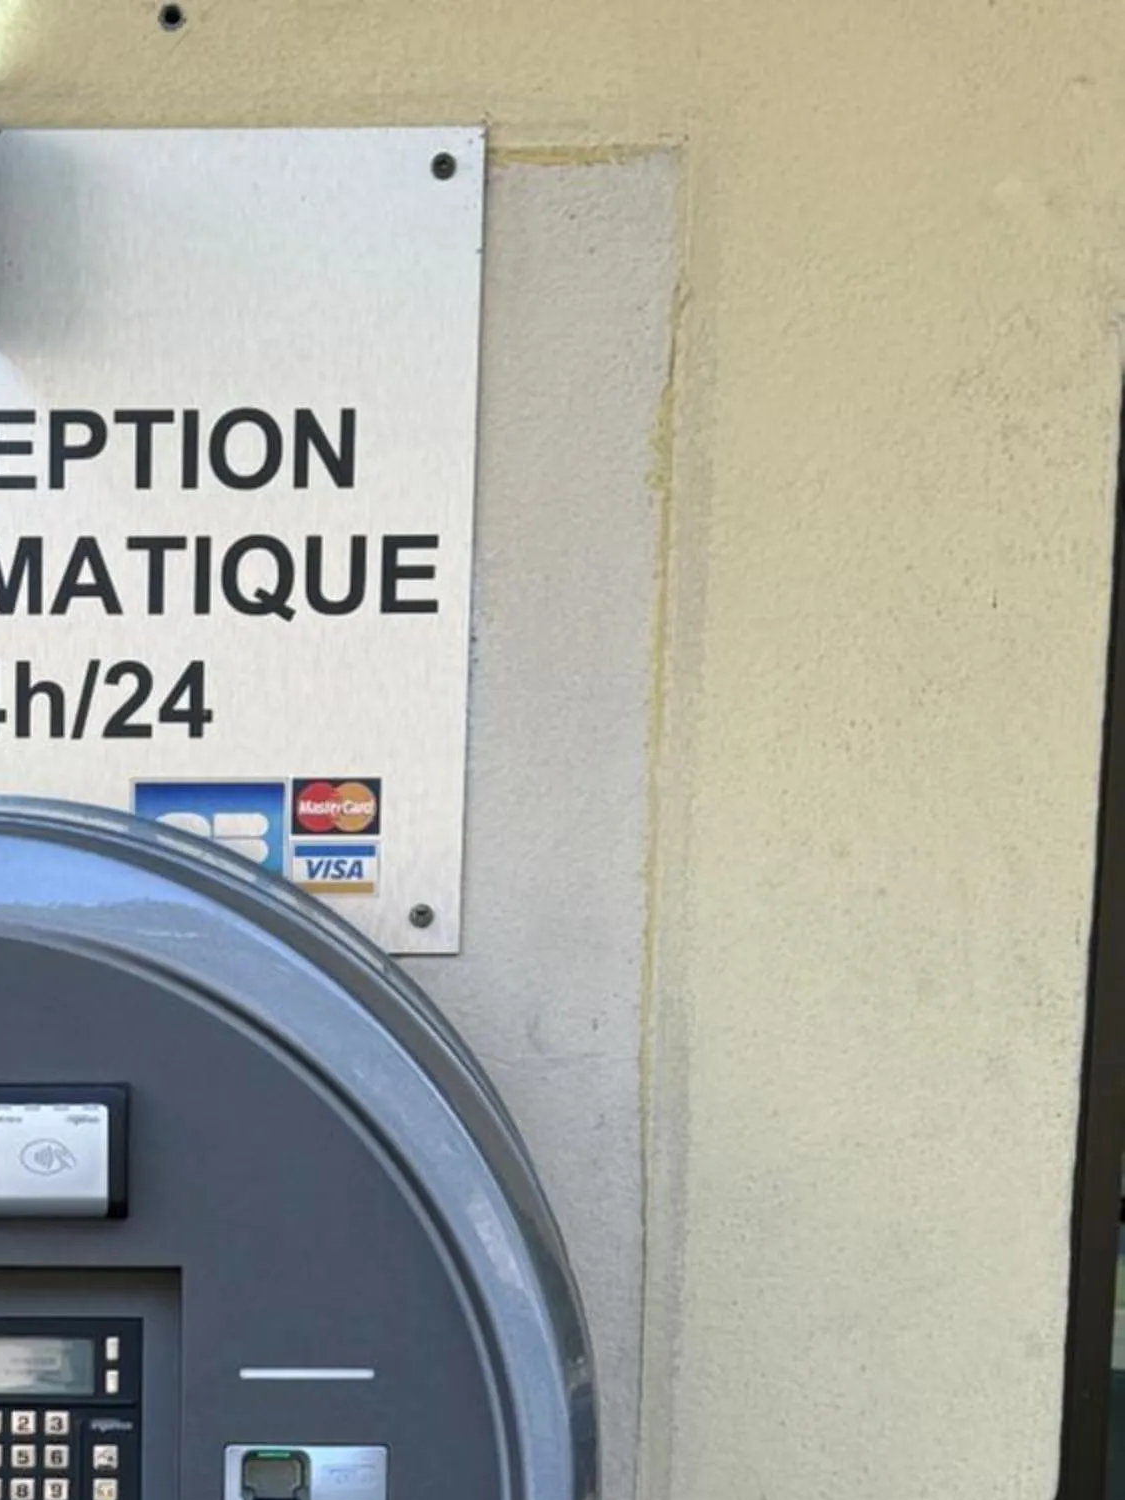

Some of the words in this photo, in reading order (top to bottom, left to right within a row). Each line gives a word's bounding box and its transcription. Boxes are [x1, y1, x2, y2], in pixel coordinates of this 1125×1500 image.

[298, 799, 375, 817] MasterCard
[306, 859, 364, 879] VISA
[18, 1416, 29, 1431] 2
[51, 1416, 63, 1432] 3
[17, 1450, 28, 1465] 5
[50, 1450, 63, 1465] 6
[16, 1483, 29, 1498] 8
[50, 1483, 63, 1498] 9
